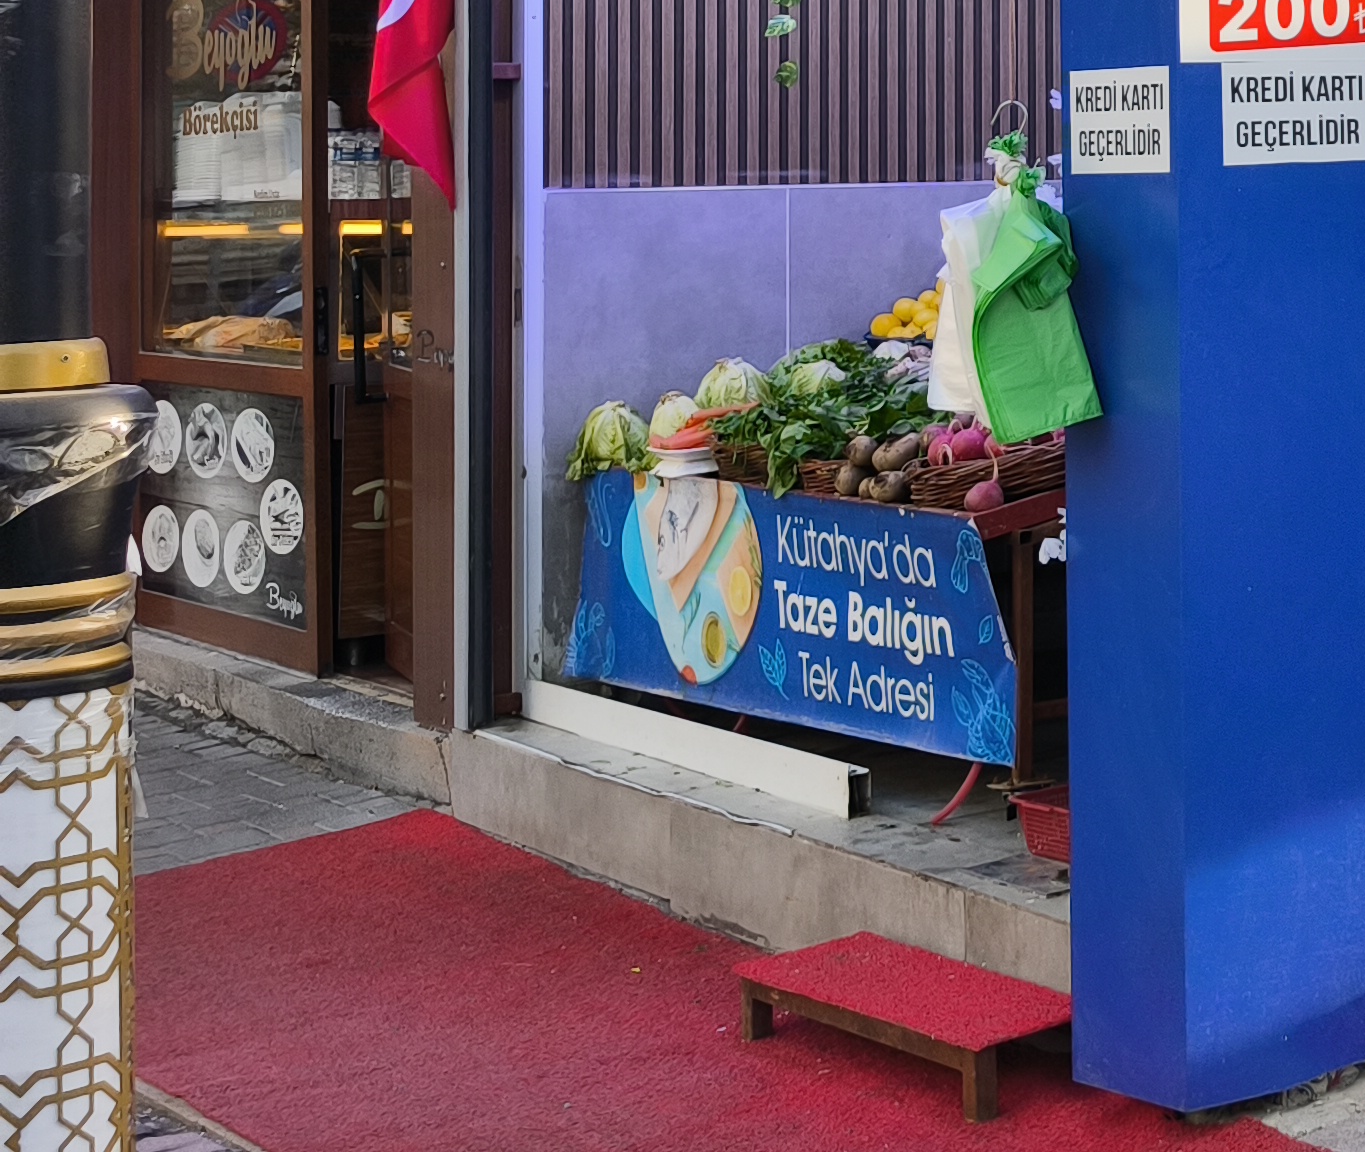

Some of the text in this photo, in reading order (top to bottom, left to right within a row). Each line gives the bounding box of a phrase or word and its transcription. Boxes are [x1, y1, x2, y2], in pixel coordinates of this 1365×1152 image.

[1075, 79, 1165, 114] KREDİ KARTI
[1230, 71, 1365, 104] KREDİ KARTI
[182, 99, 259, 140] Börekçisi
[1235, 114, 1362, 153] GEÇERLİDİR
[1078, 122, 1162, 162] GEÇERLİDİR
[775, 513, 936, 589] Kütahya'da
[773, 580, 955, 666] Taze Balığın
[797, 650, 936, 722] Tek Adresi
